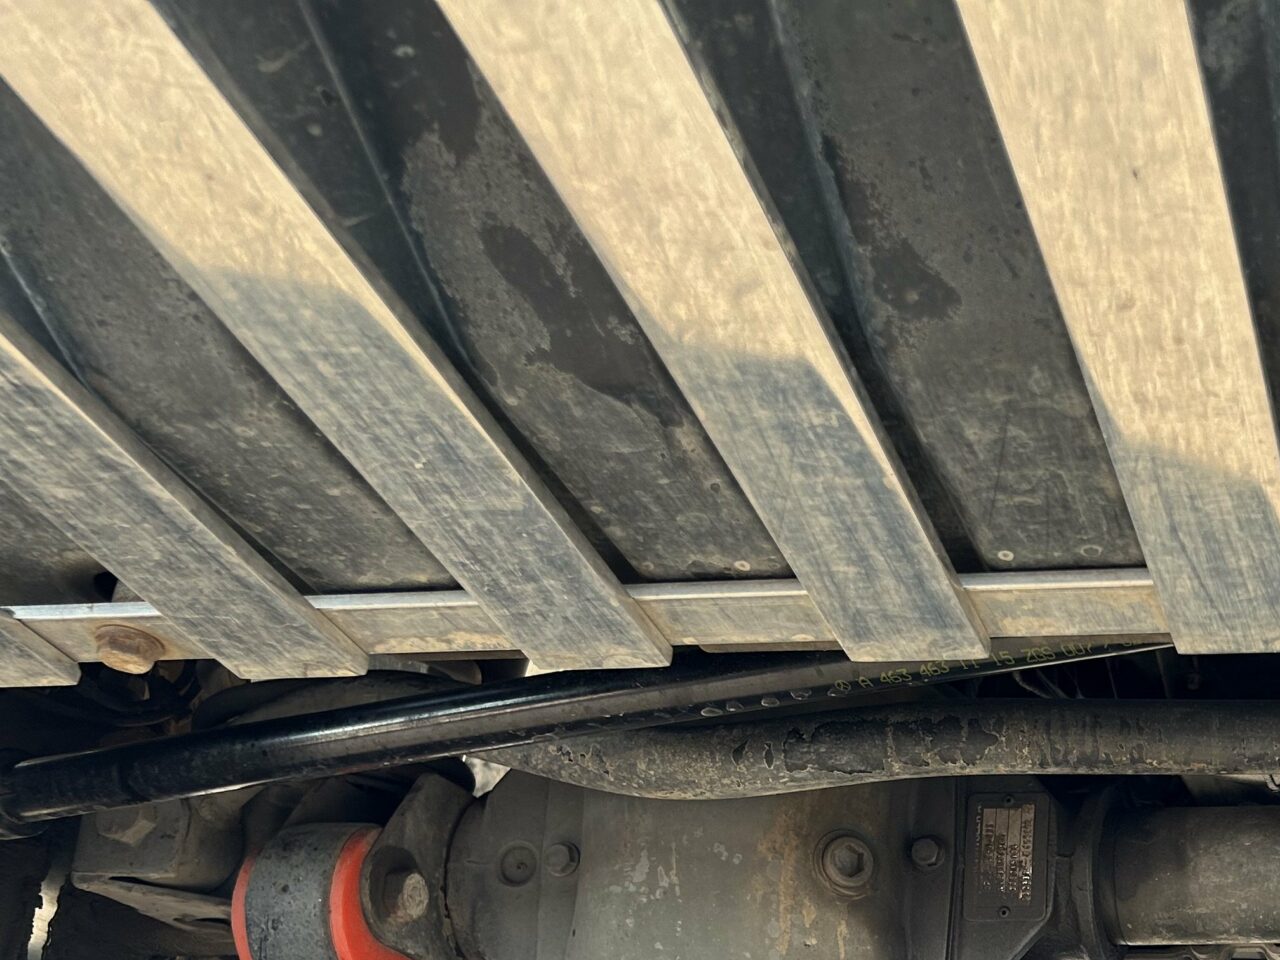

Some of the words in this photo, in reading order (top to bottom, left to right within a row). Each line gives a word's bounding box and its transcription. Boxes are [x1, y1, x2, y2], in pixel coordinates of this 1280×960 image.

[858, 676, 873, 689] A
[879, 668, 912, 685] 463
[919, 659, 949, 677] 463
[991, 650, 1015, 668] 15
[1024, 645, 1056, 664] ZGS
